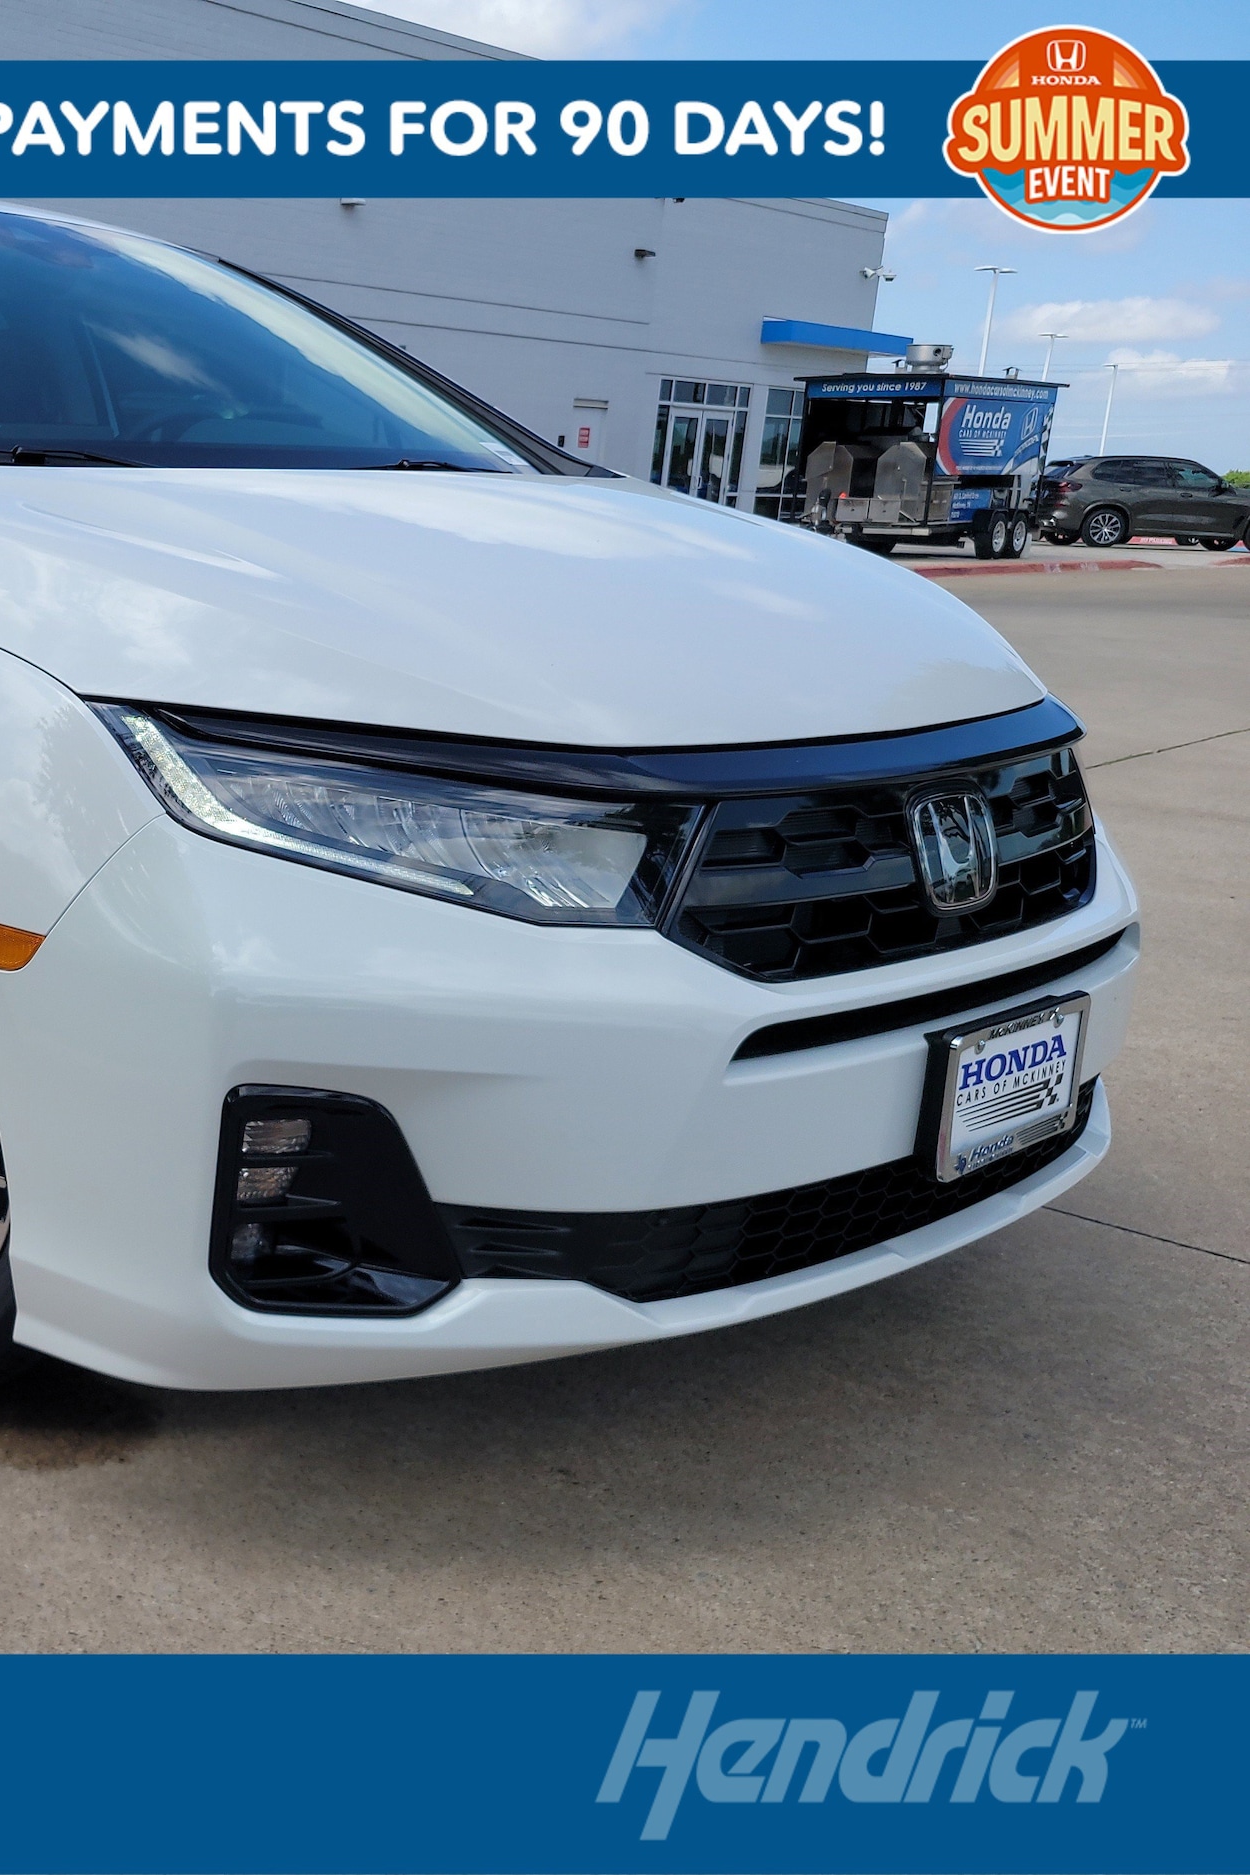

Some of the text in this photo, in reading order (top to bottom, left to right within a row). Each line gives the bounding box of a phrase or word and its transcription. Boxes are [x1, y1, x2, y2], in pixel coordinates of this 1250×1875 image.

[821, 381, 928, 393] Serving you since 1987
[961, 404, 1012, 430] Honda
[958, 1034, 1067, 1091] HONDA
[956, 1059, 1066, 1106] CARS OF MCKINNEY
[968, 1134, 1014, 1162] Honda
